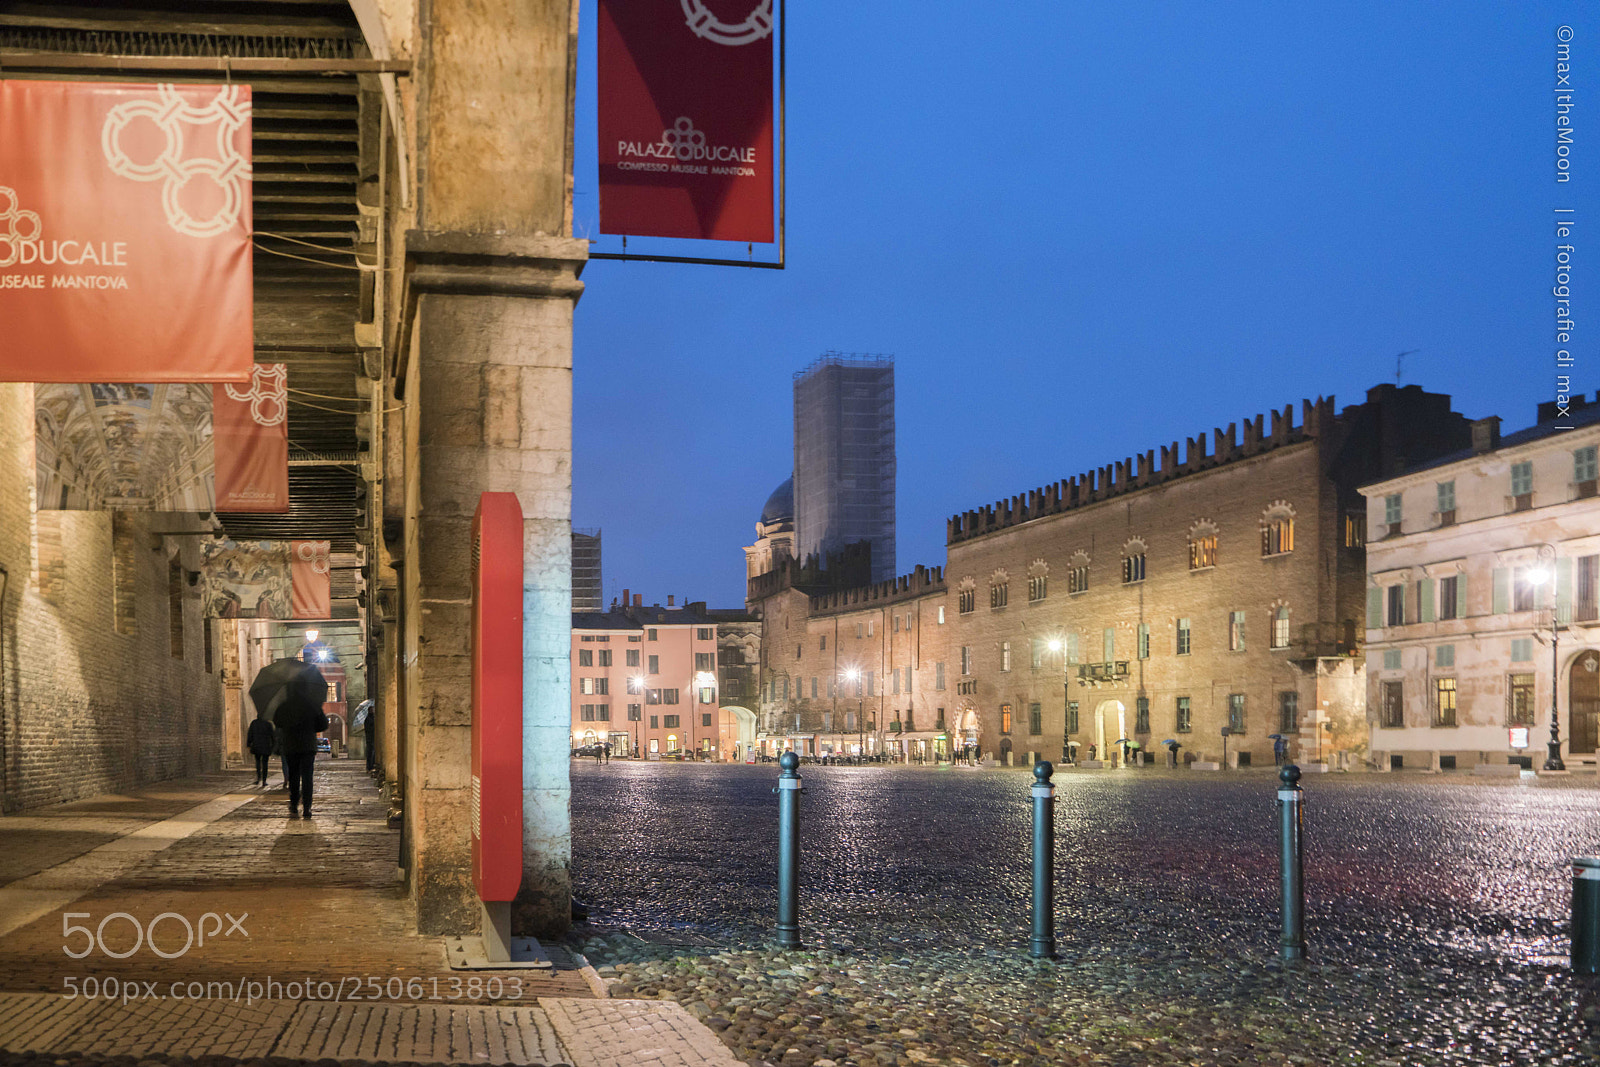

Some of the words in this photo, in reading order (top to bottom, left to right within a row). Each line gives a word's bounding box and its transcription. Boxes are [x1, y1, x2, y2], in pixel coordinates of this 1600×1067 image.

[617, 161, 669, 173] COMPLESSO
[670, 164, 708, 175] MUSEALE
[711, 166, 756, 177] MANTOVA
[51, 274, 129, 290] MANTOVA
